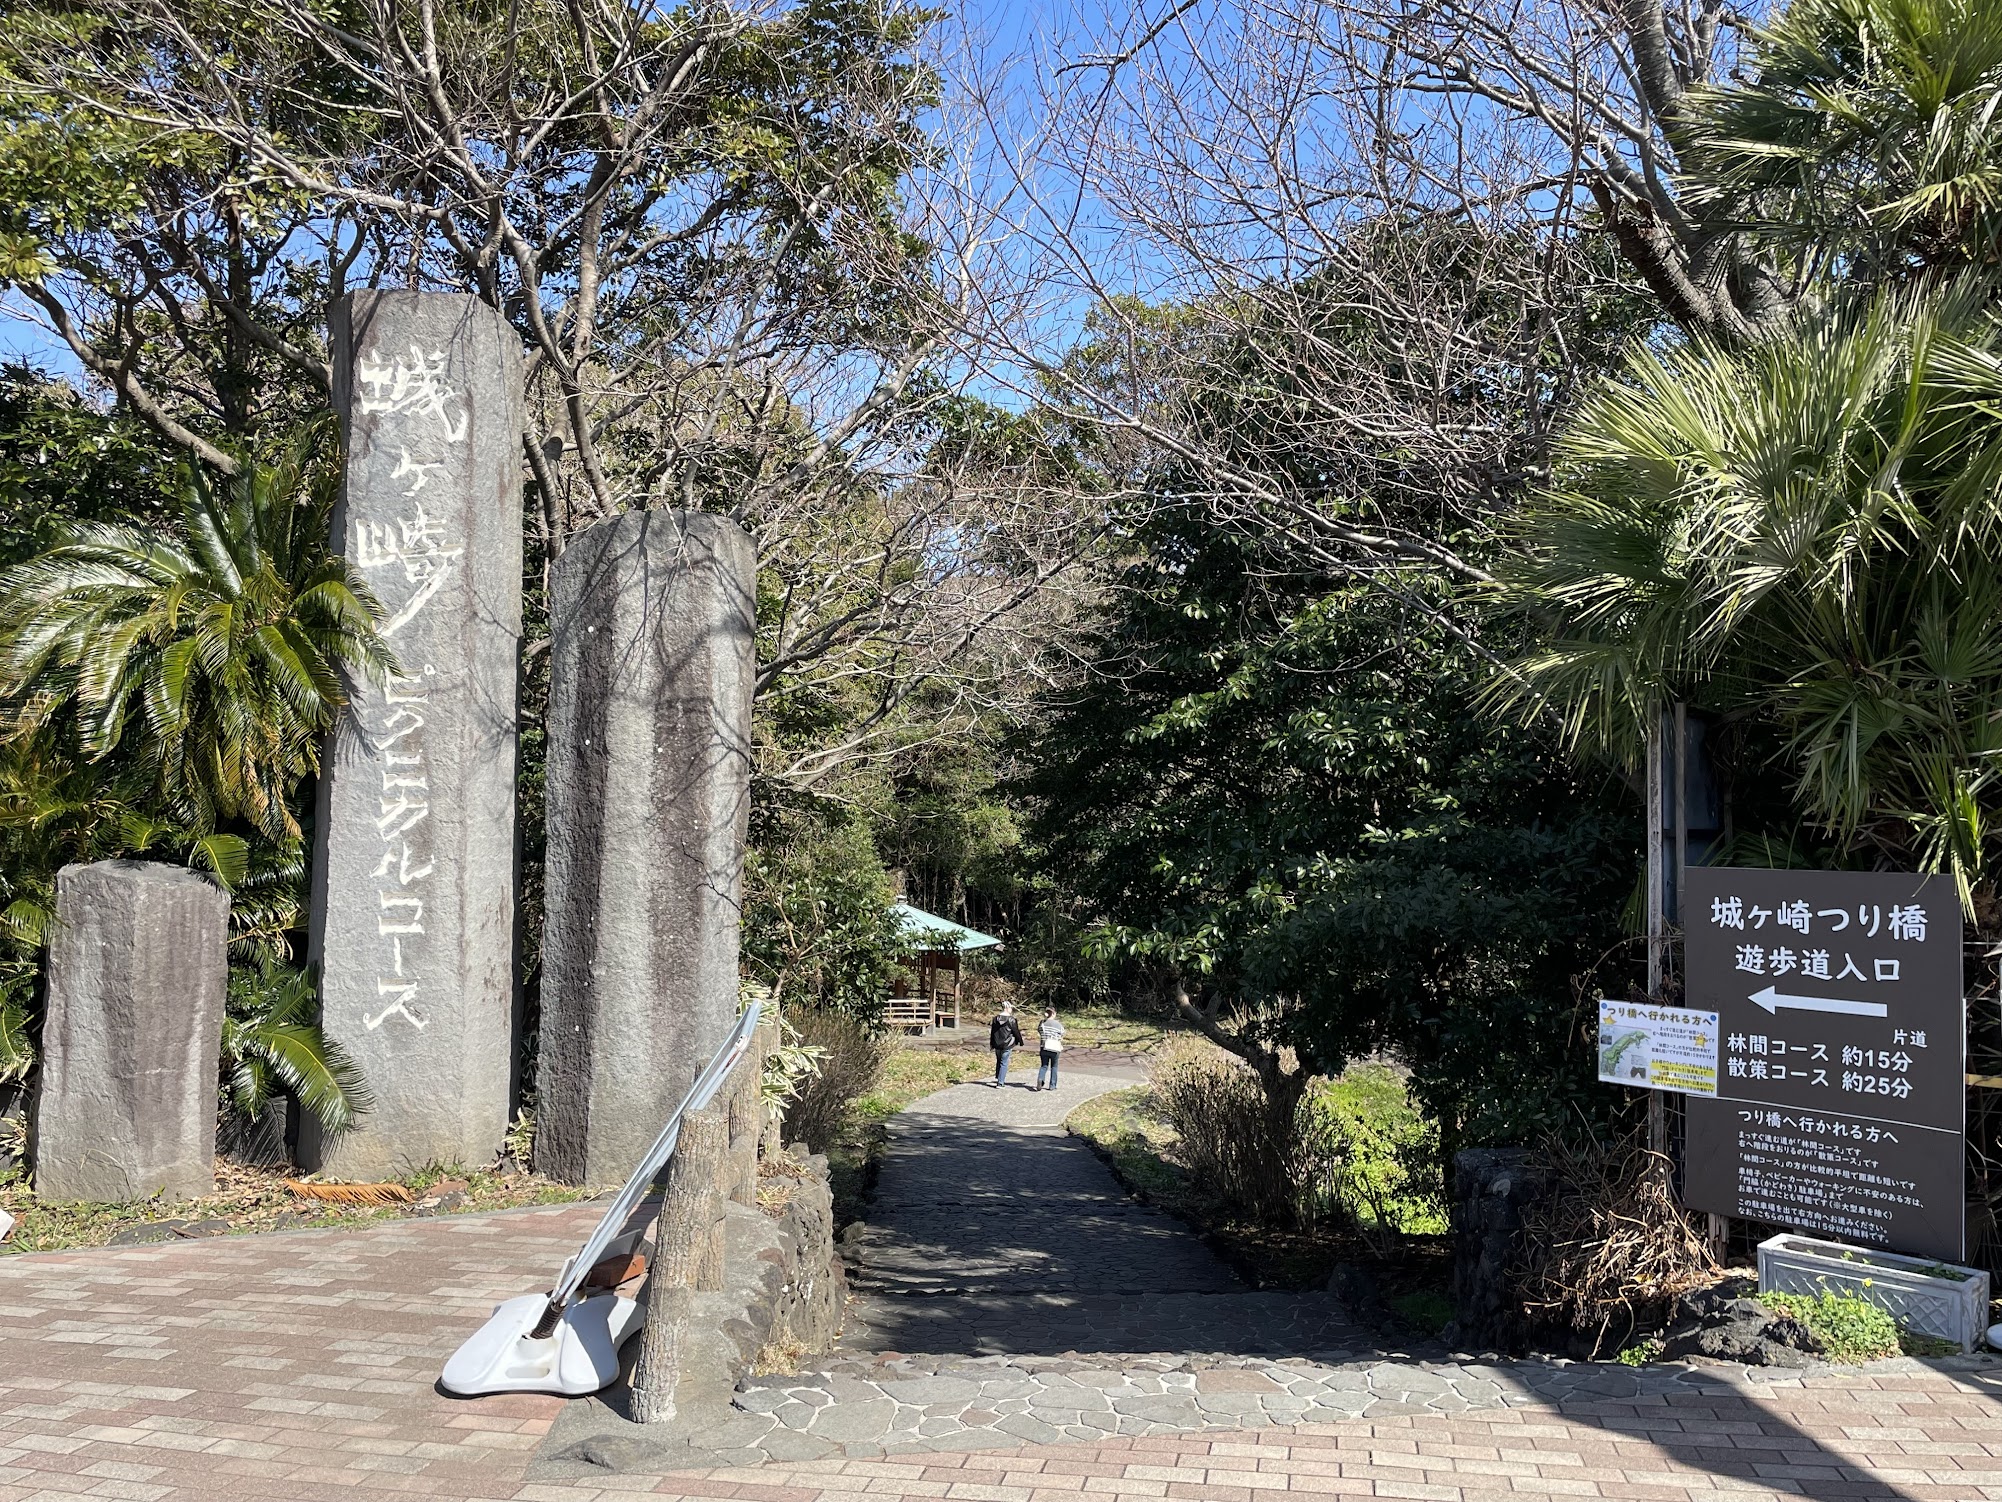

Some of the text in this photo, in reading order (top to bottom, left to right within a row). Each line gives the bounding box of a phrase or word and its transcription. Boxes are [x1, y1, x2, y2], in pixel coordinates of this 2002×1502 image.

[1710, 896, 1928, 942] 城ヶ崎つり橋
[1735, 944, 1900, 983] 遊歩道入口
[1607, 1007, 1713, 1026] つり橋へ行かれる方へ
[1727, 1033, 1830, 1062] 林間コース
[1841, 1045, 1914, 1073] 約15分
[1893, 1029, 1927, 1048] 片道
[1727, 1057, 1830, 1088] 散策コース
[1841, 1072, 1914, 1099] 約25分
[1738, 1109, 1899, 1144] つり橋へ行かれる方へ
